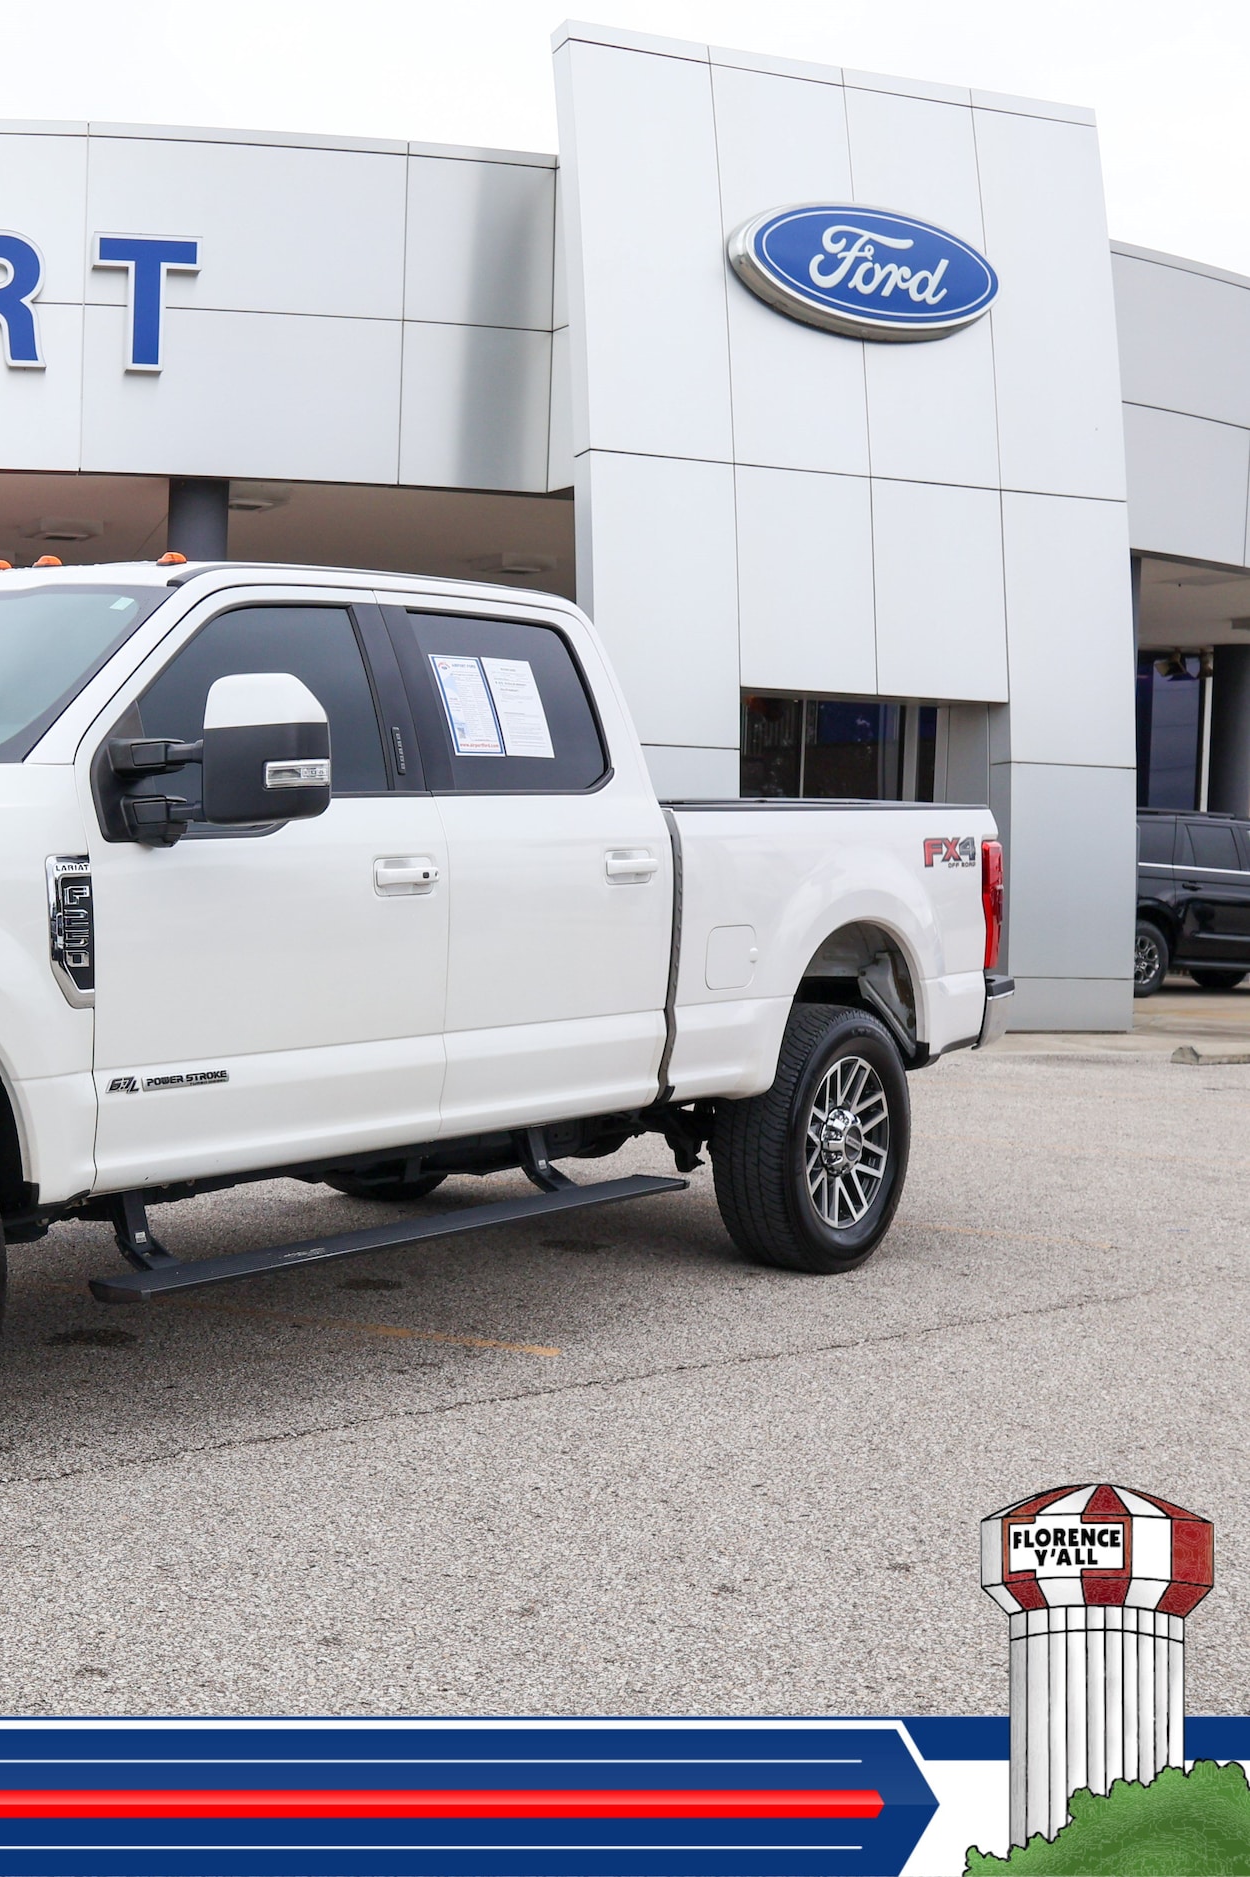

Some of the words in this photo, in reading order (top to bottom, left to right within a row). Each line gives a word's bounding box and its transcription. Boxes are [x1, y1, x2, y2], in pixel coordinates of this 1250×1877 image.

[808, 224, 950, 305] Ford
[923, 837, 976, 868] FX4
[55, 863, 90, 872] LARIAT
[107, 1075, 140, 1094] 6.7L
[146, 1075, 184, 1087] POWER
[186, 1069, 228, 1082] STROKE
